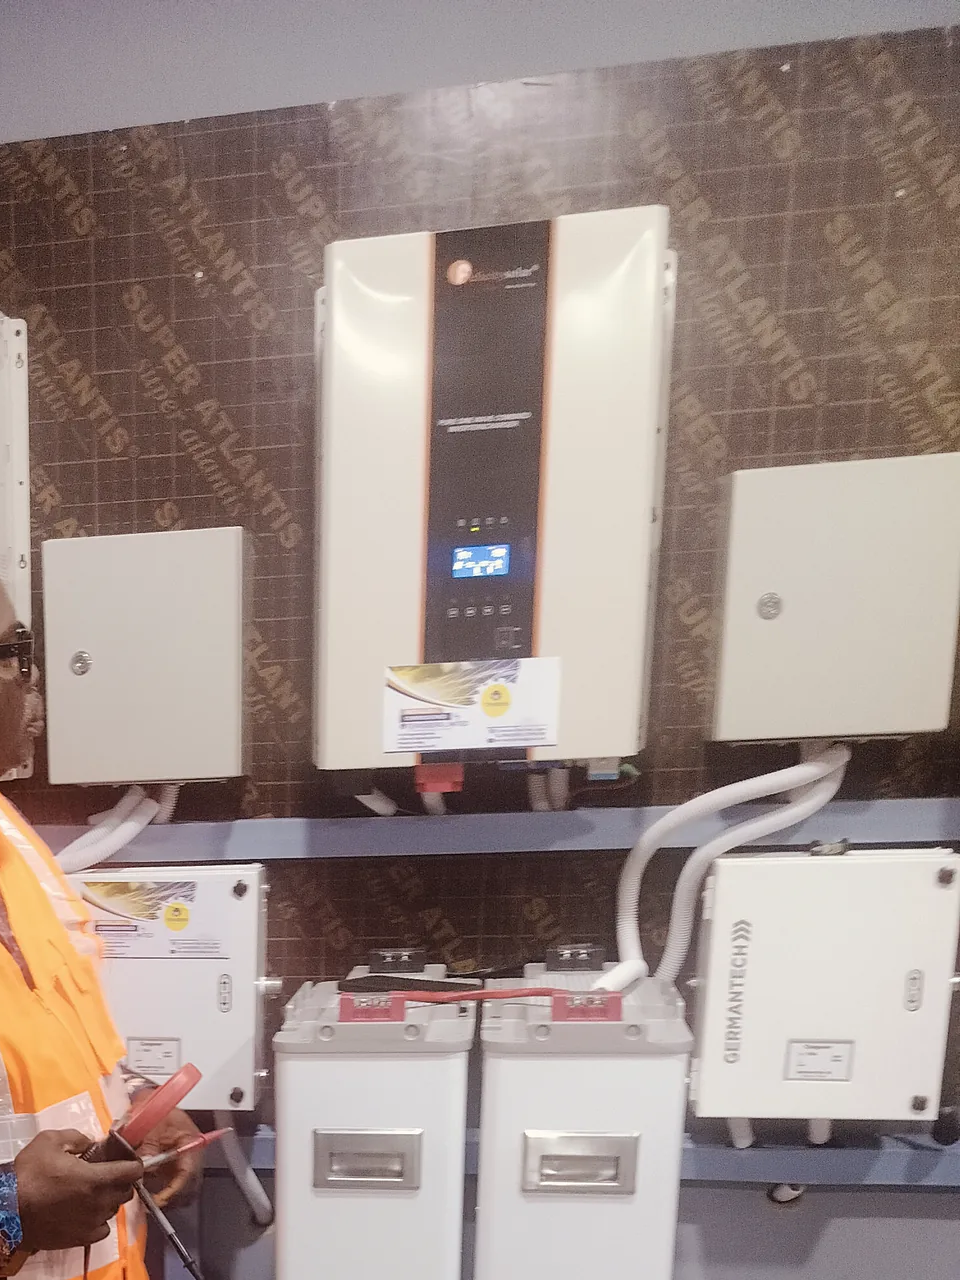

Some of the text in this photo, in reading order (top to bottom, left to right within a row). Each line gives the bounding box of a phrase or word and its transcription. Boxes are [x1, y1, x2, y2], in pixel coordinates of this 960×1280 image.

[122, 283, 203, 396] SUPER
[193, 397, 304, 549] ATLANTIS
[723, 943, 751, 1065] GERMANTECH
